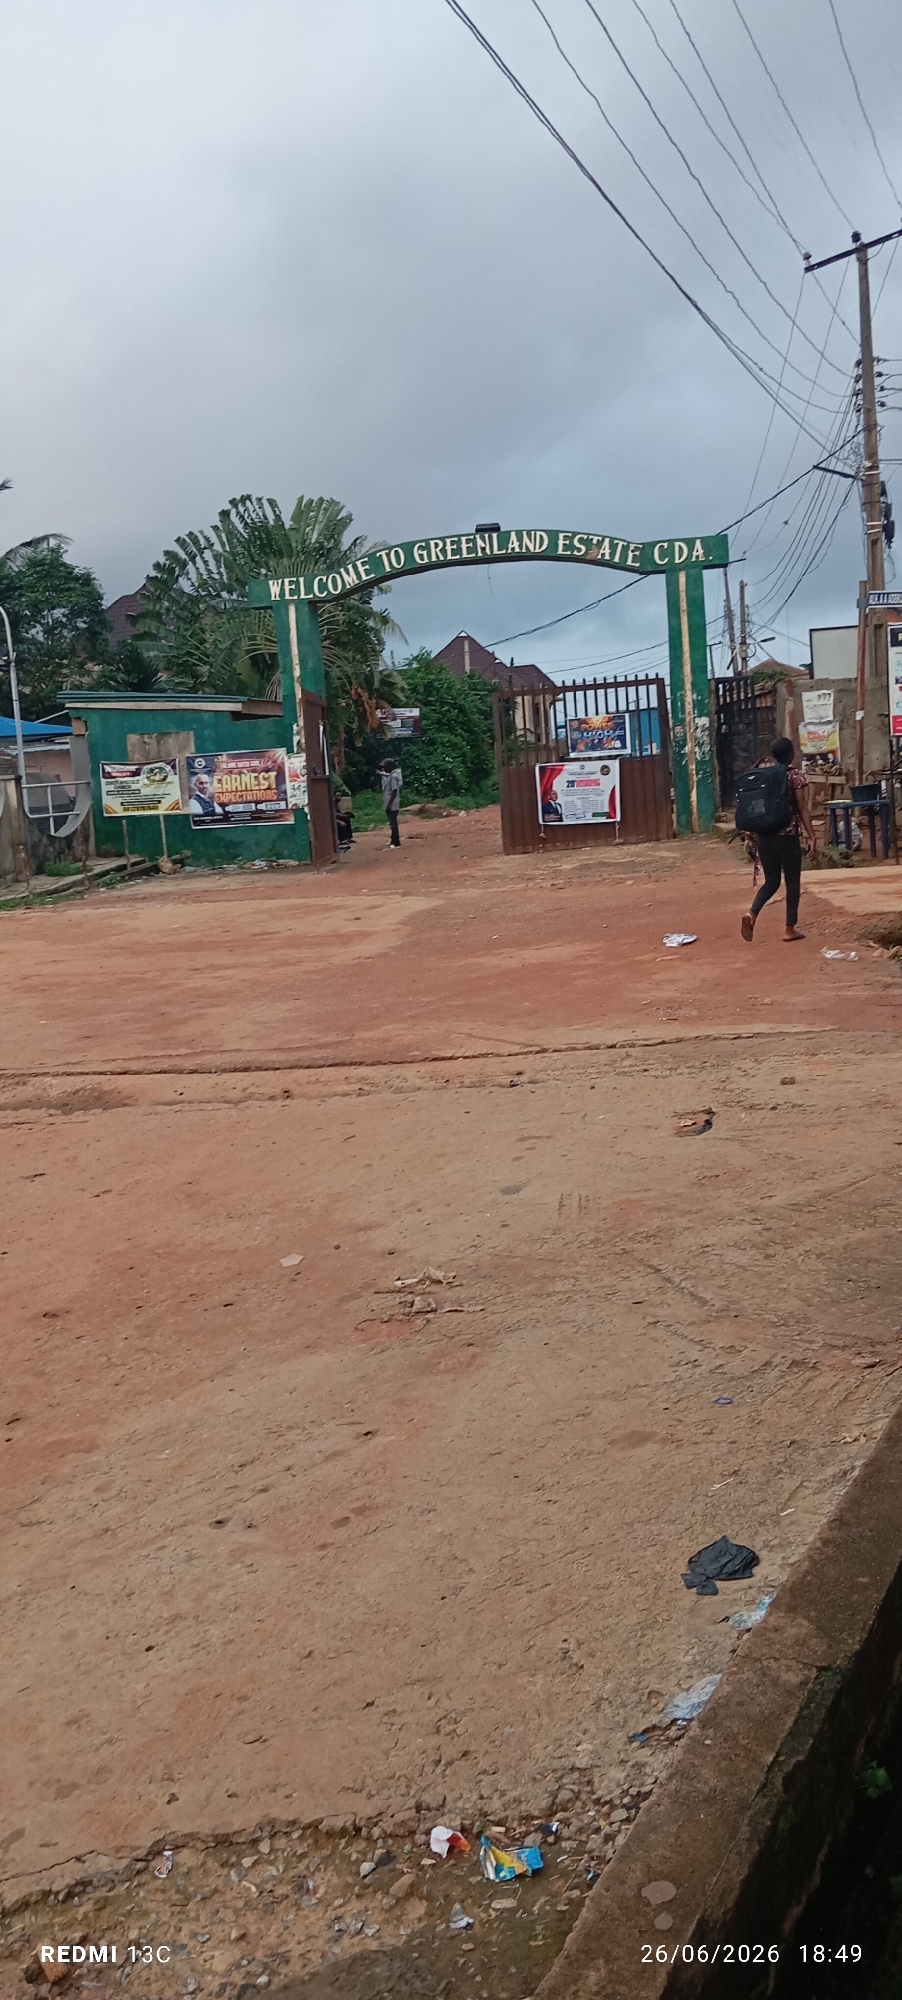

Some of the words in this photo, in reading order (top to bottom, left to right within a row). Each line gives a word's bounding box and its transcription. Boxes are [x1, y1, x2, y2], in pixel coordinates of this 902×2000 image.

[268, 558, 375, 601] WELCOME
[376, 547, 406, 573] TO
[413, 530, 549, 565] GREENLAND
[557, 532, 643, 567] ESTATE
[214, 771, 278, 792] EARNEST
[214, 789, 278, 804] EXPECTATIONS
